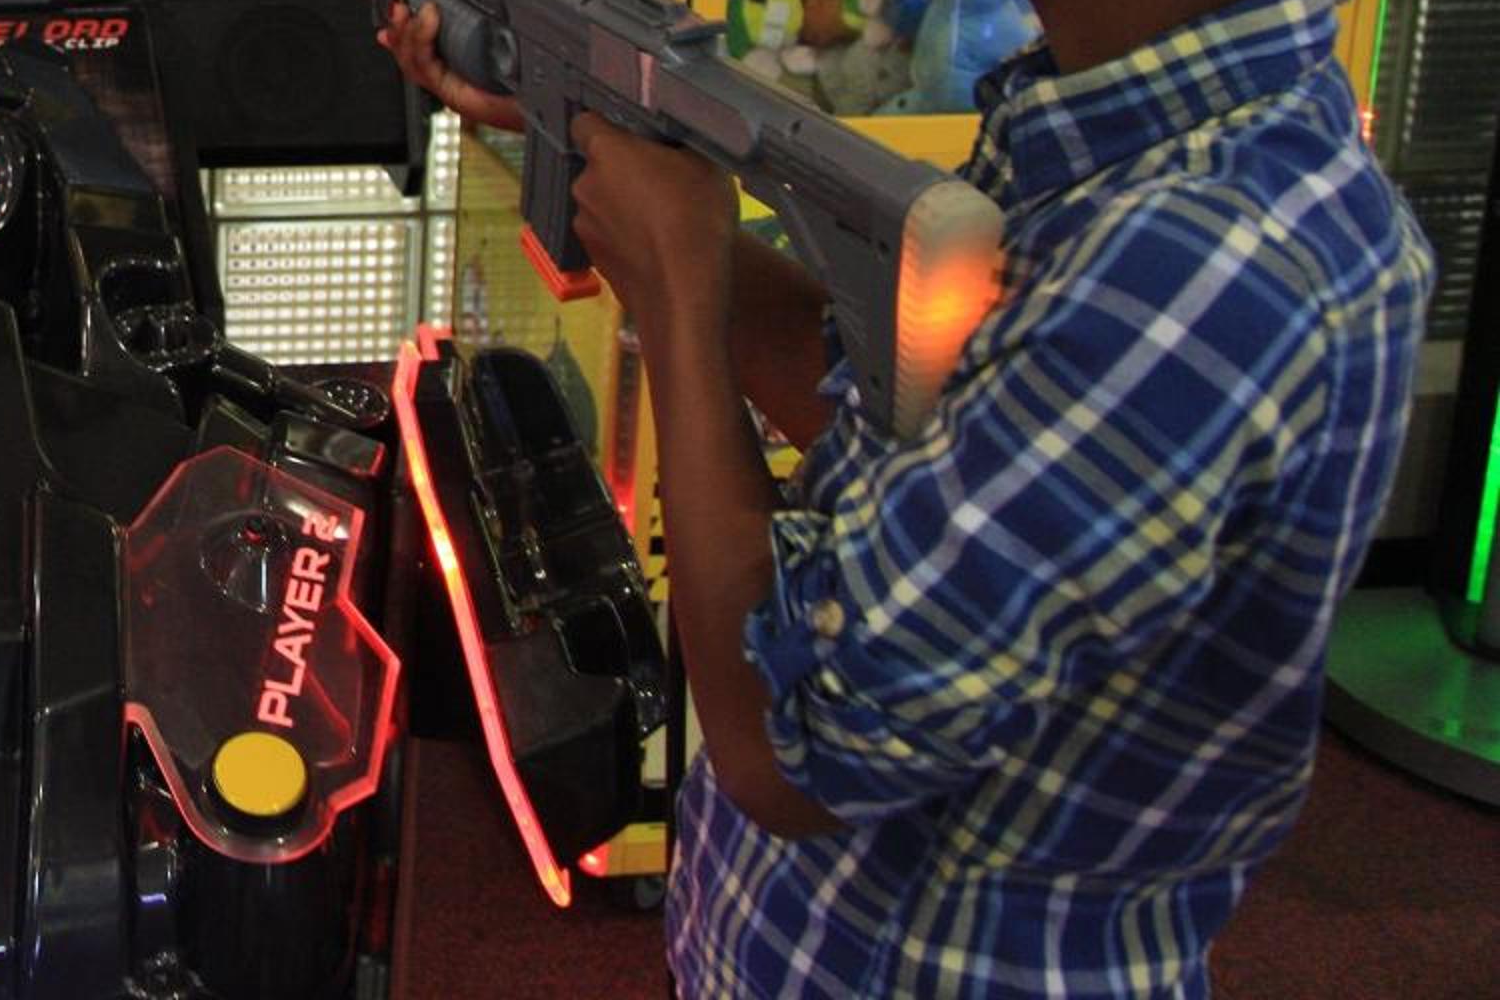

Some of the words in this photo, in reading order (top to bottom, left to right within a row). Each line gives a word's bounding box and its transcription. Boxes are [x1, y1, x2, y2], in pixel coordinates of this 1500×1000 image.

[63, 37, 120, 50] CLIP
[257, 547, 332, 728] PLAYER
[301, 512, 340, 543] 2
